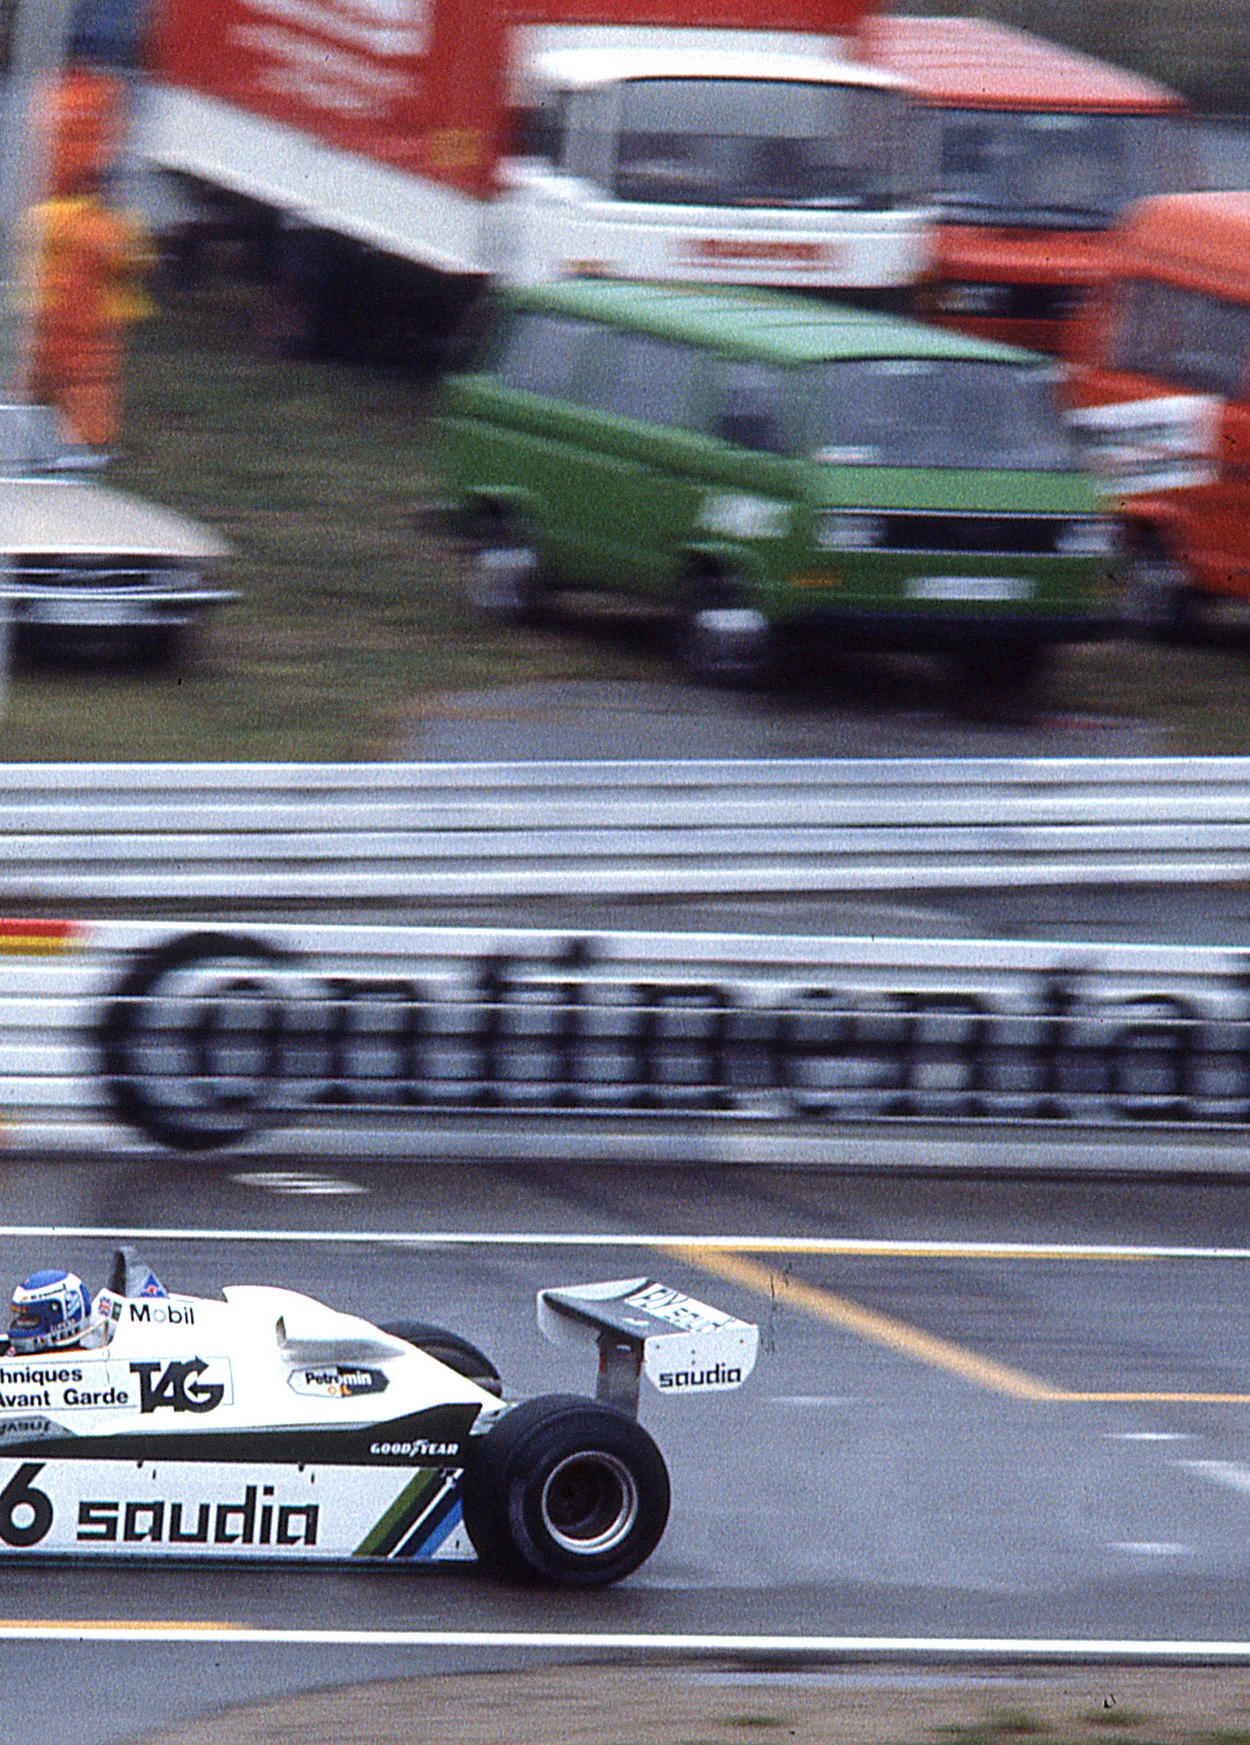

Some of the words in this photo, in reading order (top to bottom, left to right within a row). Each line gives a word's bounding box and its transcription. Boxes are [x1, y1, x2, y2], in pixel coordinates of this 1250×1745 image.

[98, 932, 1250, 1150] Continenta
[130, 1303, 195, 1326] Mobil
[129, 1355, 225, 1414] TAG
[304, 1371, 373, 1386] Petromin
[659, 1362, 742, 1388] saudia
[63, 1386, 130, 1406] Garde
[369, 1439, 460, 1458] GOODYEAR
[76, 1485, 320, 1545] saudia
